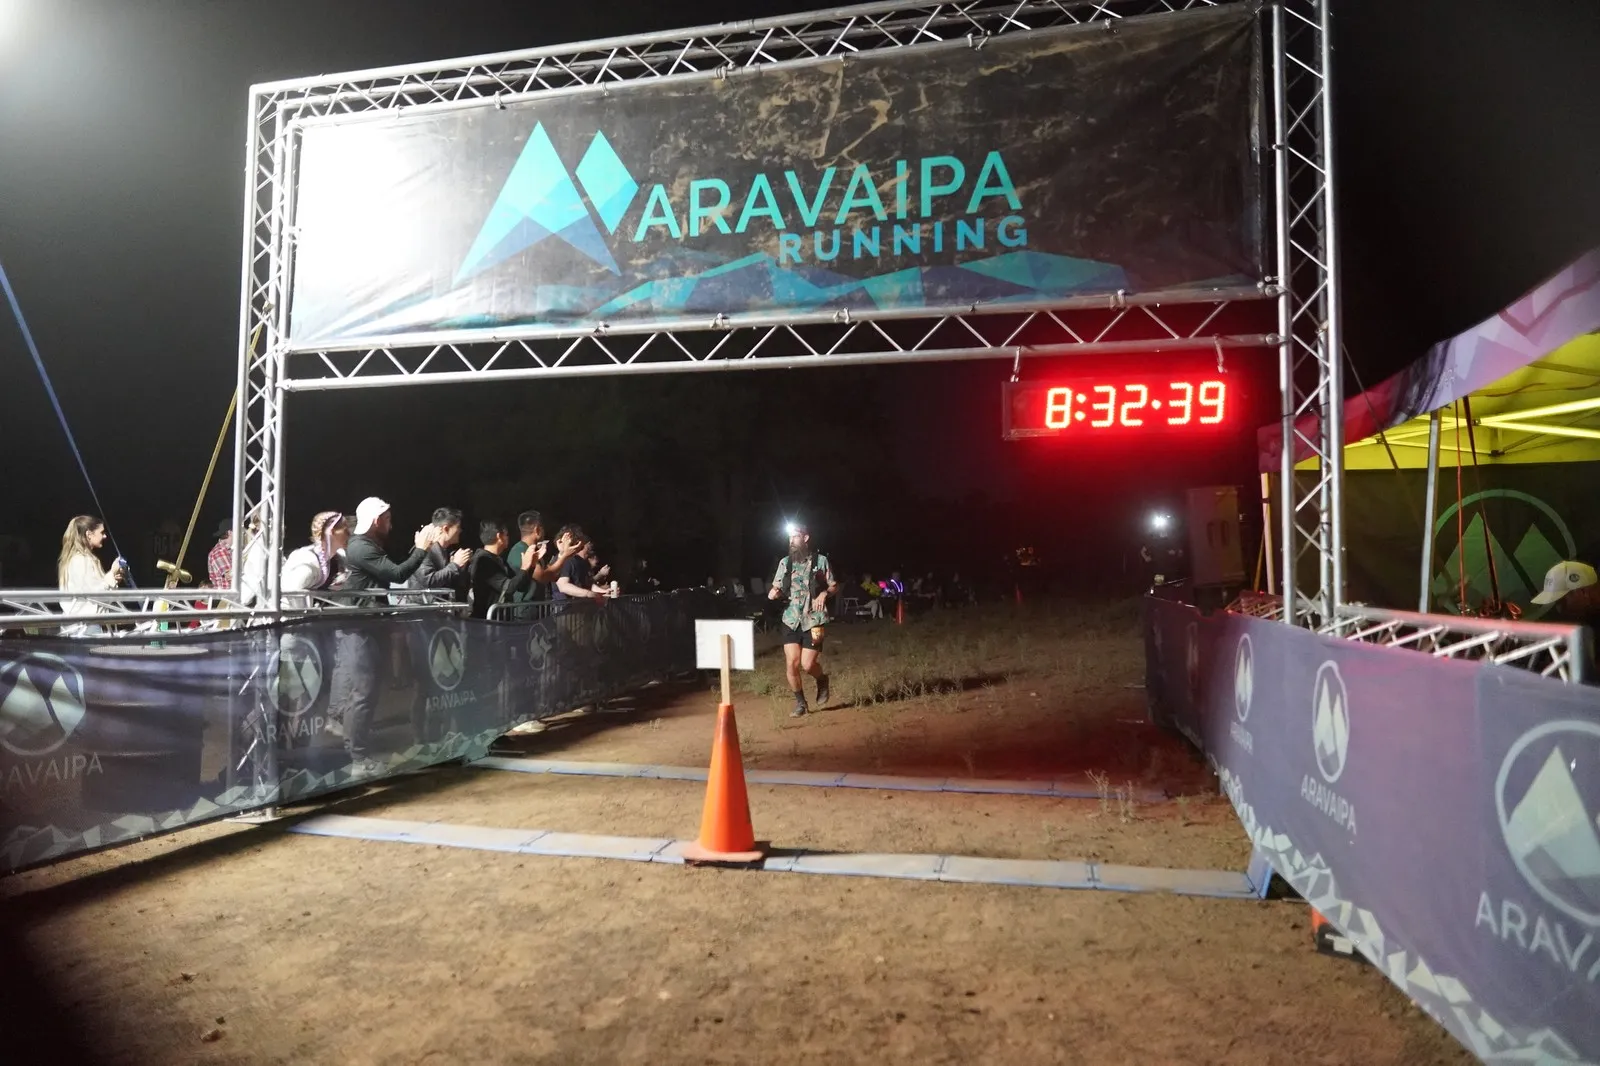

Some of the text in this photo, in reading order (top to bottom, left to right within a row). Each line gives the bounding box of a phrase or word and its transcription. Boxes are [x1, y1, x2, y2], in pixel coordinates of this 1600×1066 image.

[634, 150, 1022, 242] ARAVAIPA
[778, 216, 1027, 264] RUNNING
[425, 690, 477, 712] ARAVAIPA
[0, 752, 103, 790] AVAIPA
[1301, 774, 1356, 835] ARAVAIPA
